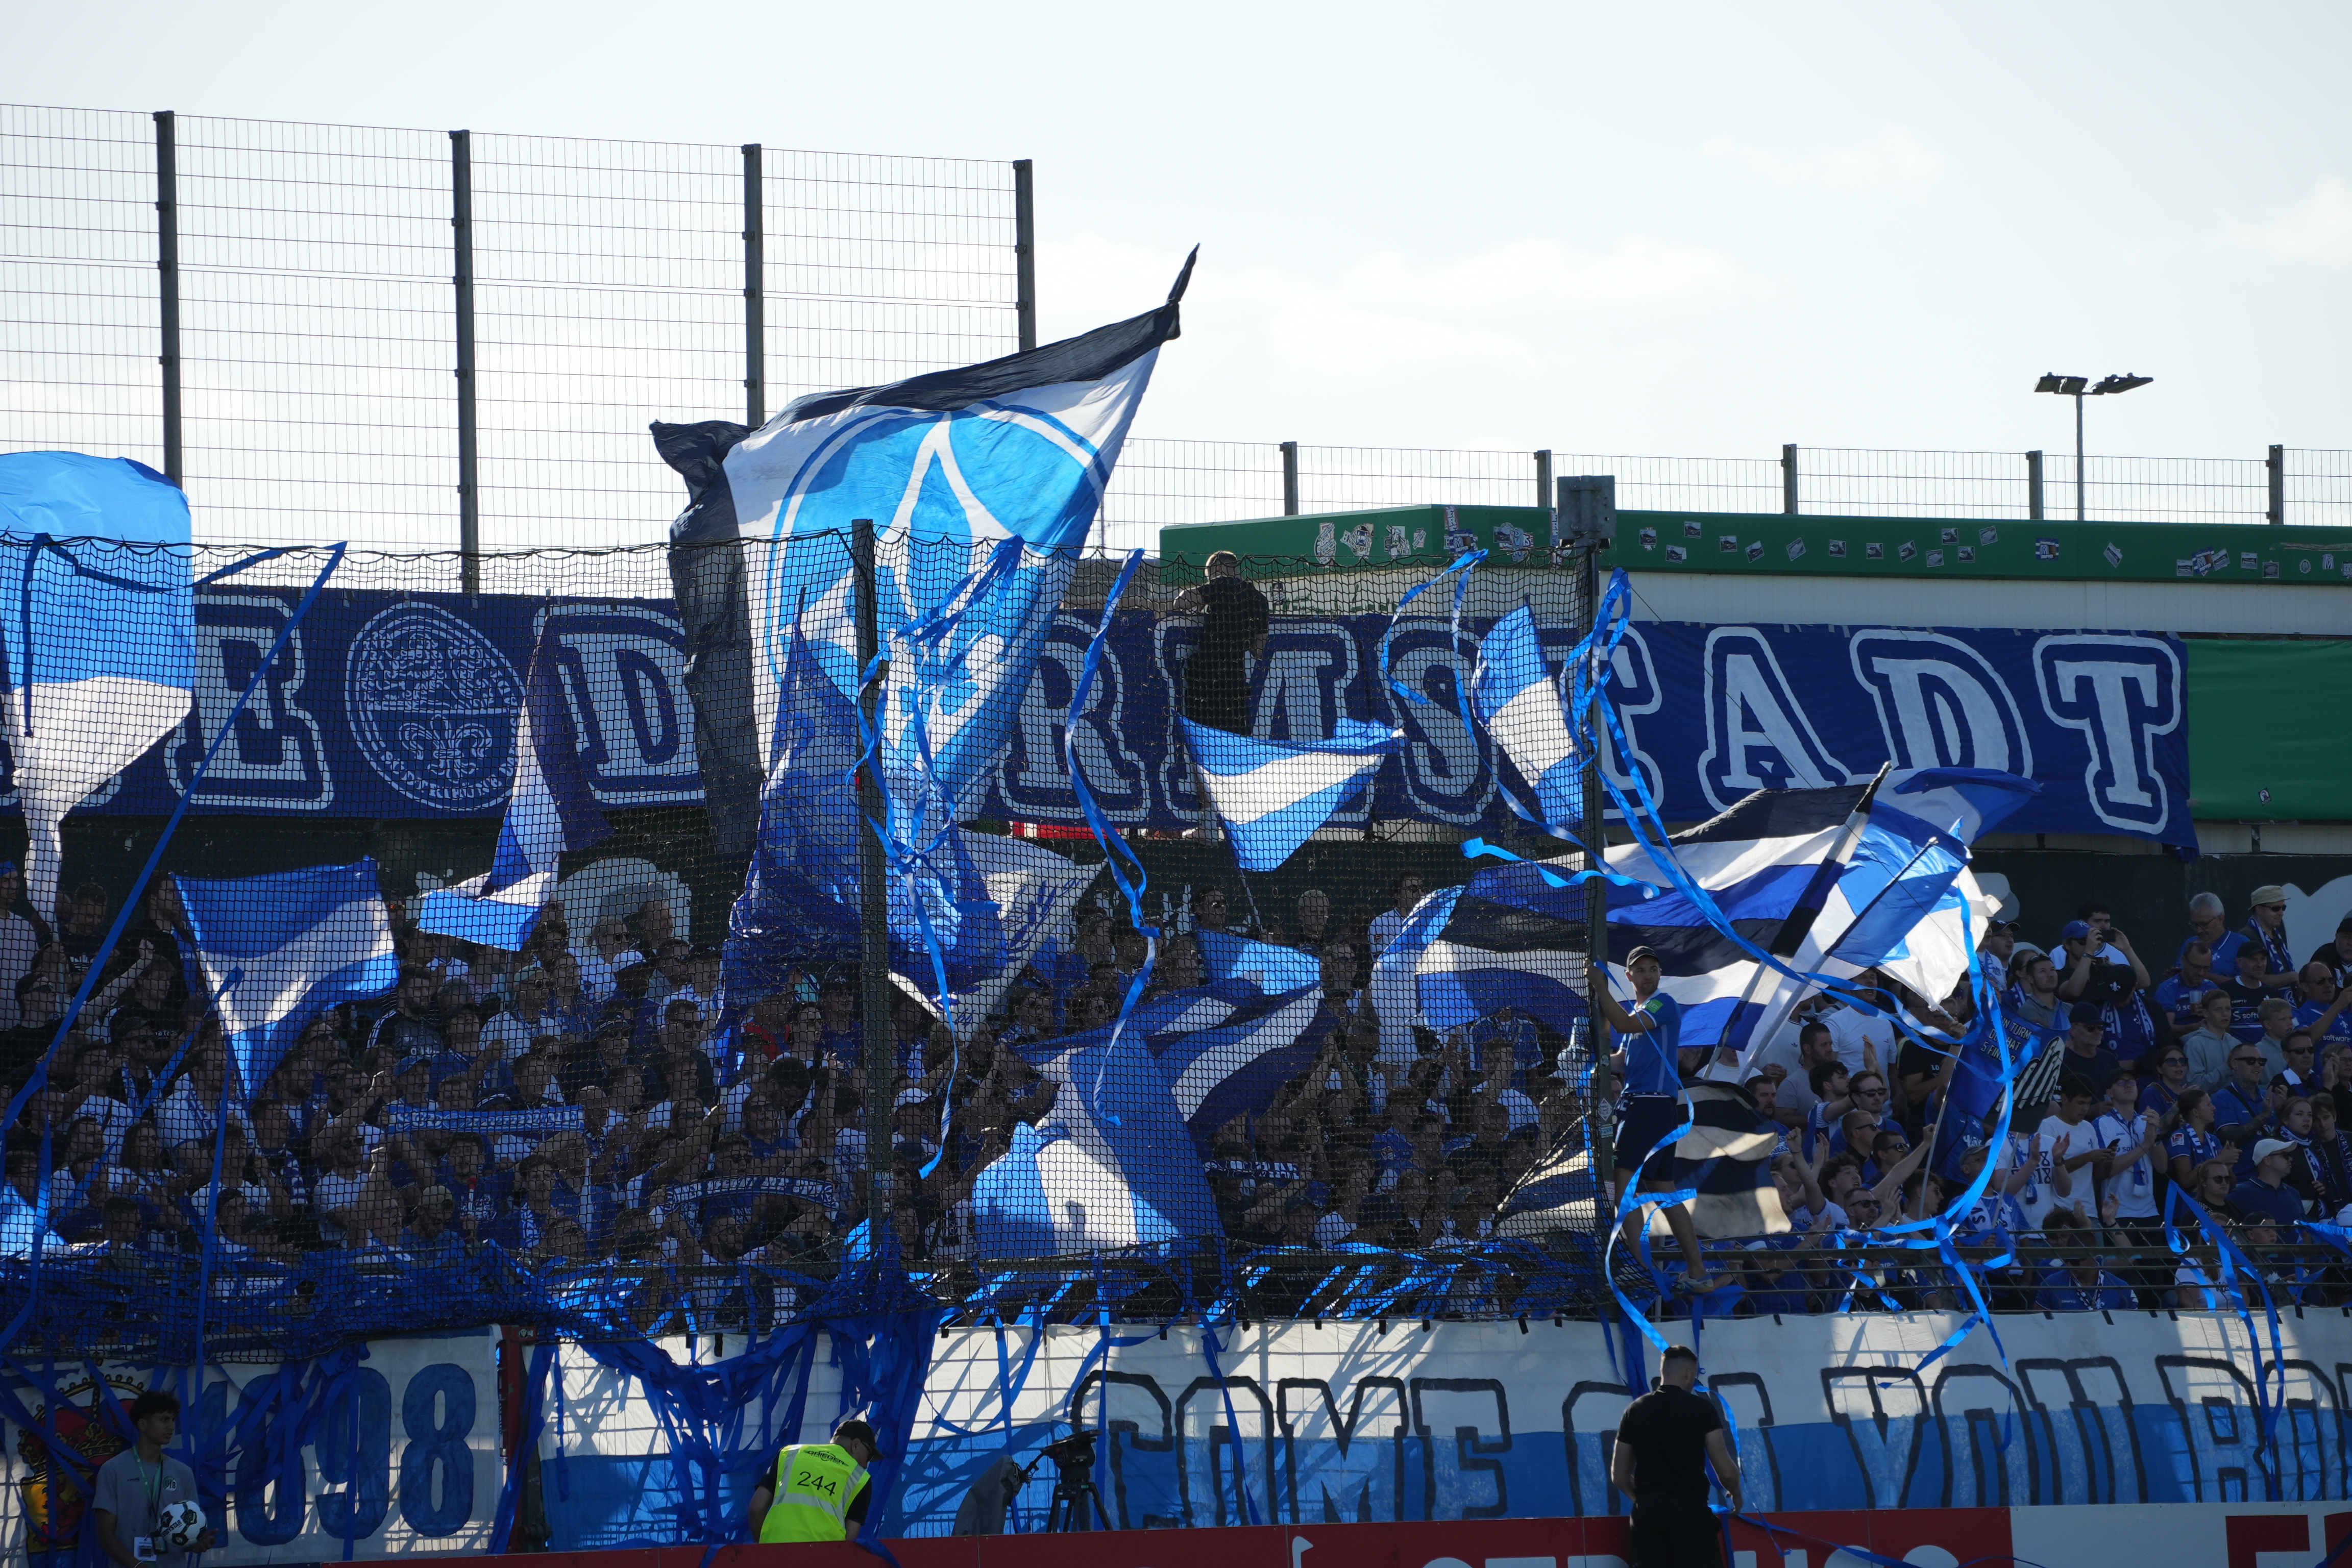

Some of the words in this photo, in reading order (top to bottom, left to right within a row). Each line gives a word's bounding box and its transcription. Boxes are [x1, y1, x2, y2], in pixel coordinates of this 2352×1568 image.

[536, 605, 2182, 834] DRSADT
[2006, 1037, 2022, 1051] HAT
[2010, 1022, 2033, 1041] TURM
[1987, 1045, 2016, 1065] FINR
[1072, 1369, 1512, 1529] COME
[1821, 1356, 2148, 1509] YOU
[2155, 1355, 2352, 1503] BO
[189, 1362, 477, 1549] 1898
[797, 1471, 837, 1496] 244
